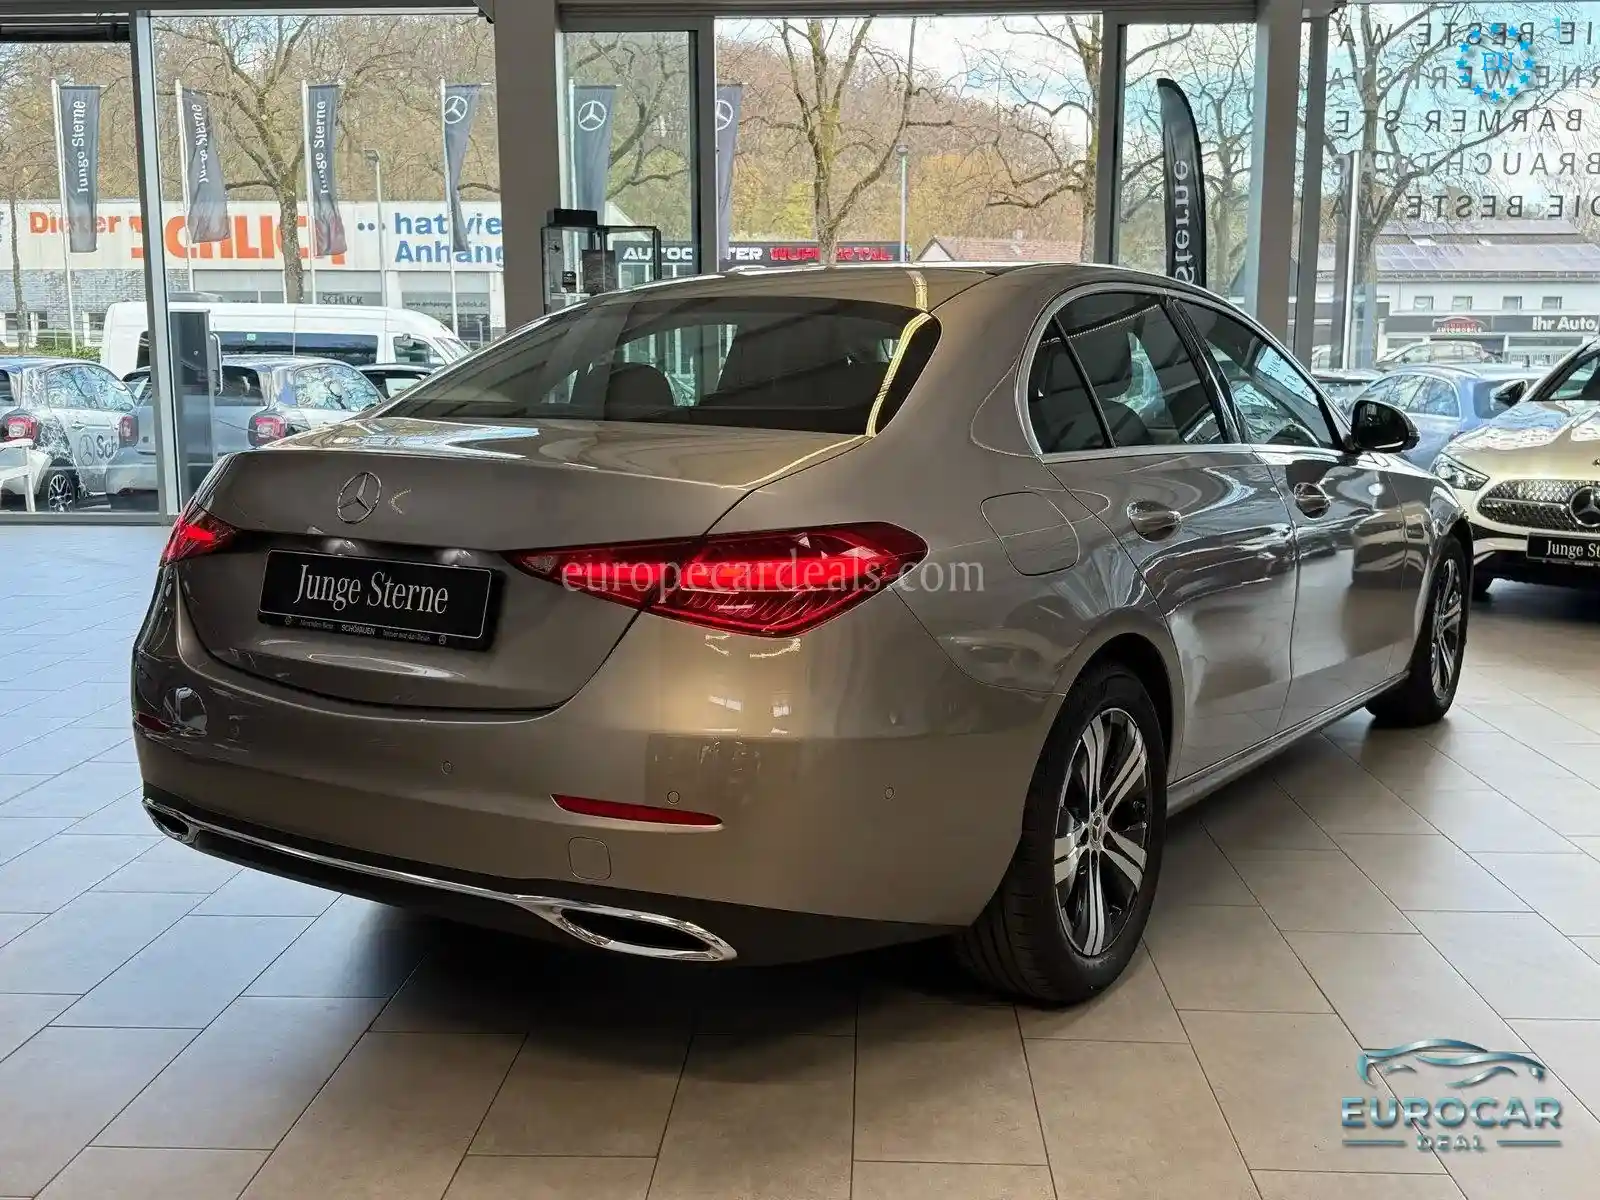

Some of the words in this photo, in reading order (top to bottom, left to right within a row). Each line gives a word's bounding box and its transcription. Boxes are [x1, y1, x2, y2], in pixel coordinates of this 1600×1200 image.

[72, 100, 86, 147] Sterne
[313, 100, 326, 148] Sterne
[76, 151, 89, 194] Junge
[394, 212, 449, 235] hat
[1532, 315, 1556, 331] Ihr
[1546, 540, 1584, 560] Junge
[293, 563, 362, 612] Junge
[366, 571, 449, 614] Sterne
